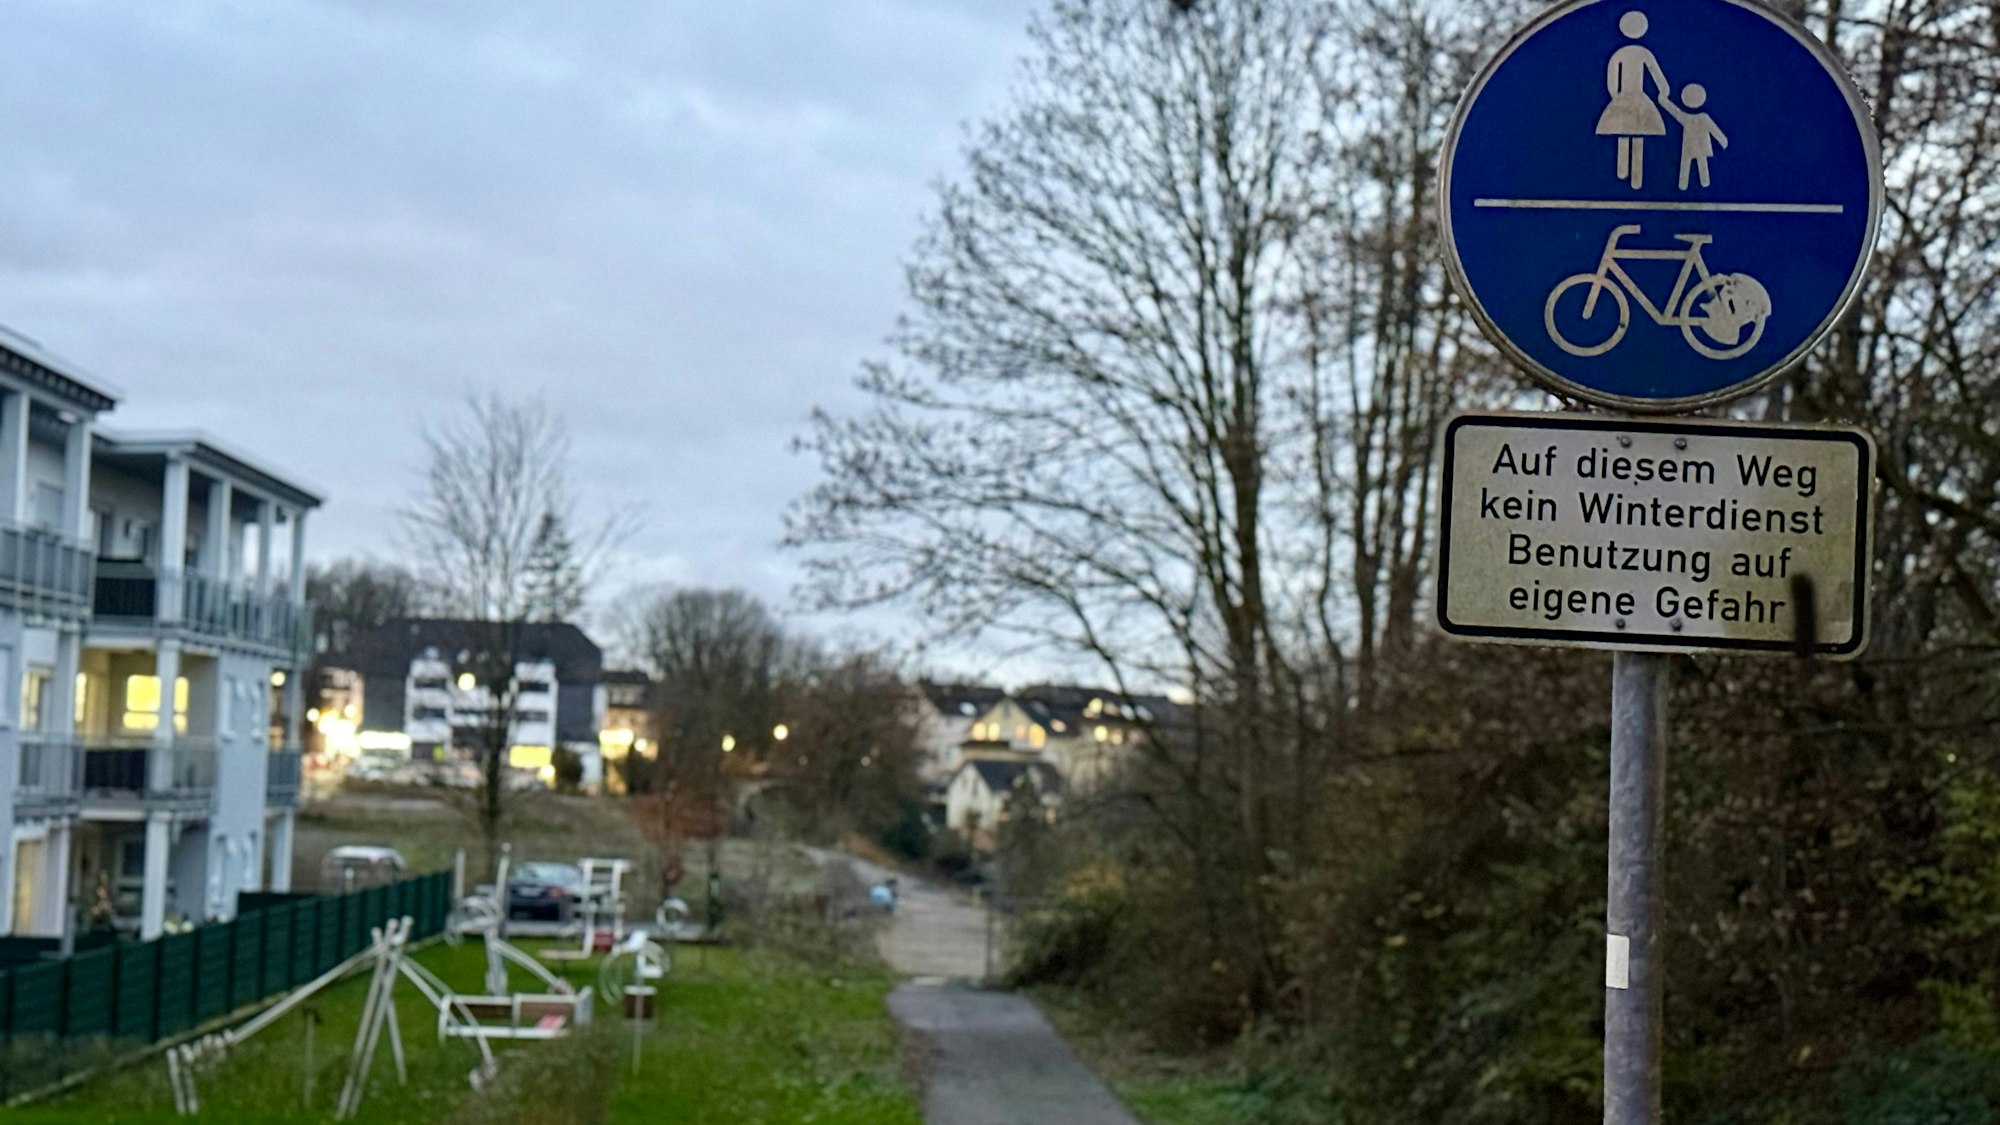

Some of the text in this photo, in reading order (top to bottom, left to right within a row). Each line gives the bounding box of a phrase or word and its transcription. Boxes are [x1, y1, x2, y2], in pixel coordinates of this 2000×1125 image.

[1492, 443, 1817, 497] Auf diesem Weg
[1480, 488, 1823, 535] kein Winterdienst
[1508, 533, 1791, 582] Benutzung auf
[1509, 580, 1786, 624] eigene Gefahr
